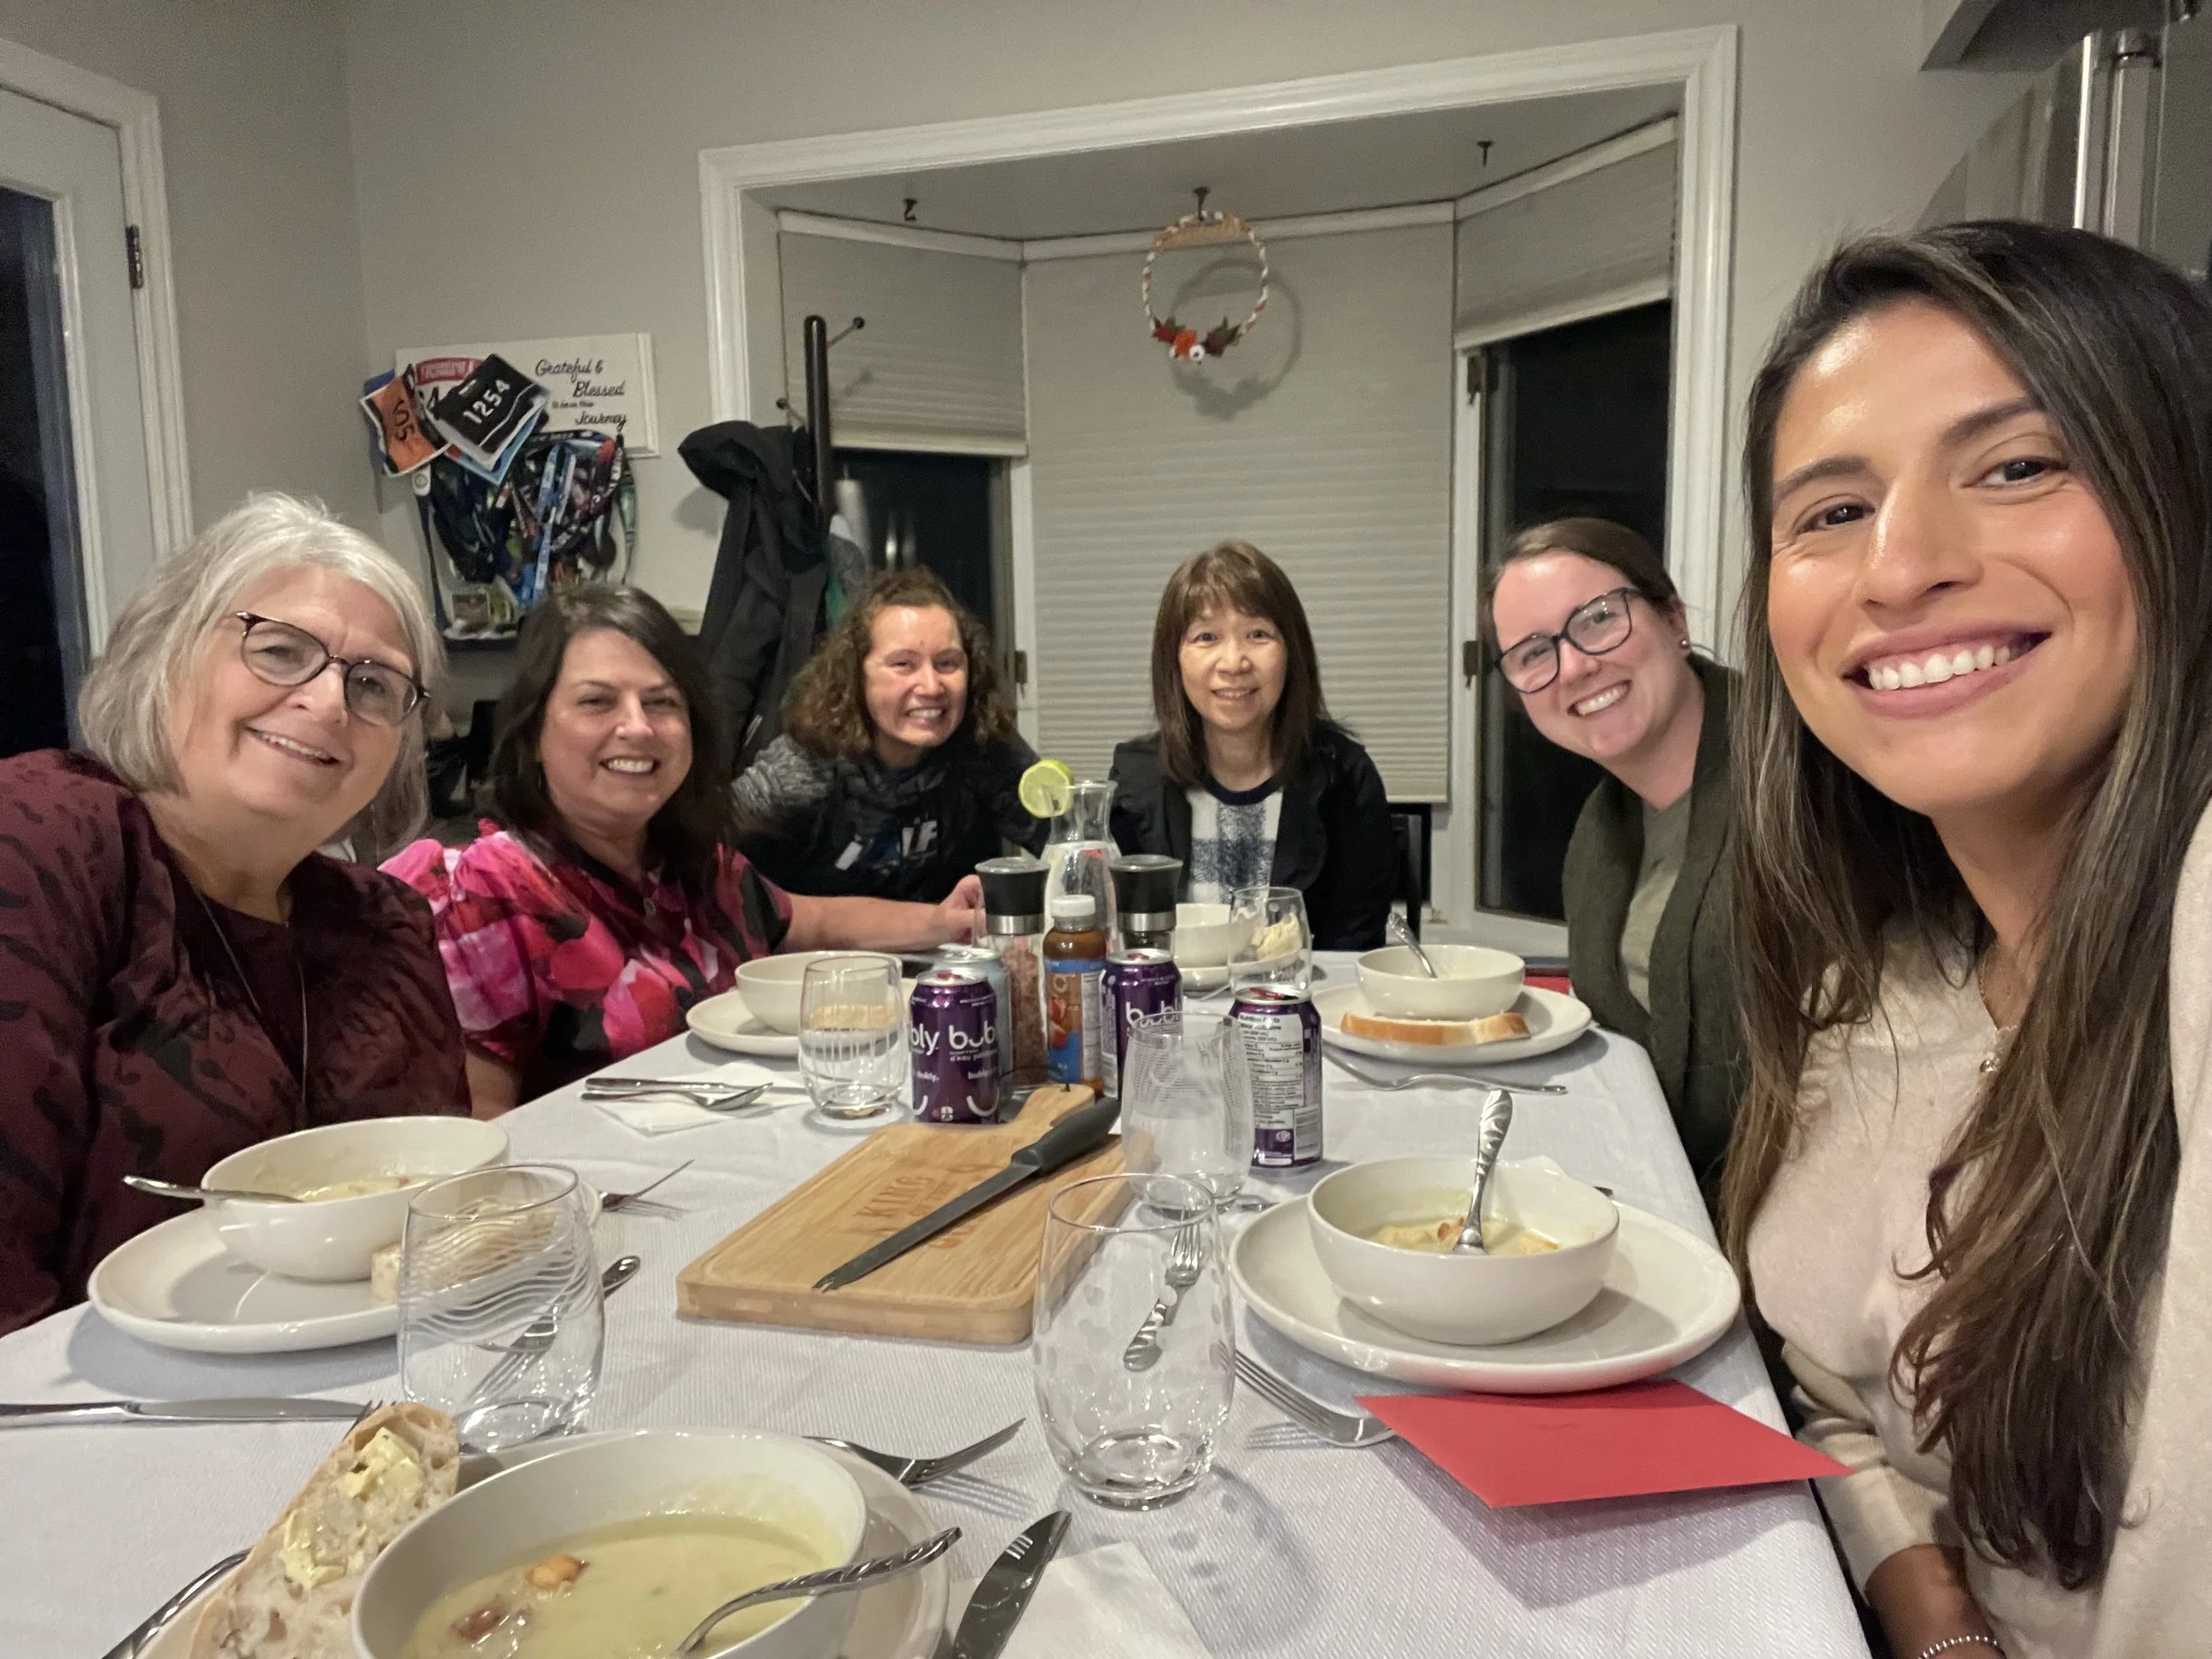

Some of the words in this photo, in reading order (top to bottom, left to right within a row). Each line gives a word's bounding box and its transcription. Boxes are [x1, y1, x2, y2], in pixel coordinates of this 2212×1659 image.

[535, 358, 592, 383] Grateful
[572, 380, 625, 397] Blessed
[463, 379, 511, 424] 1254
[574, 410, 627, 433] Journey
